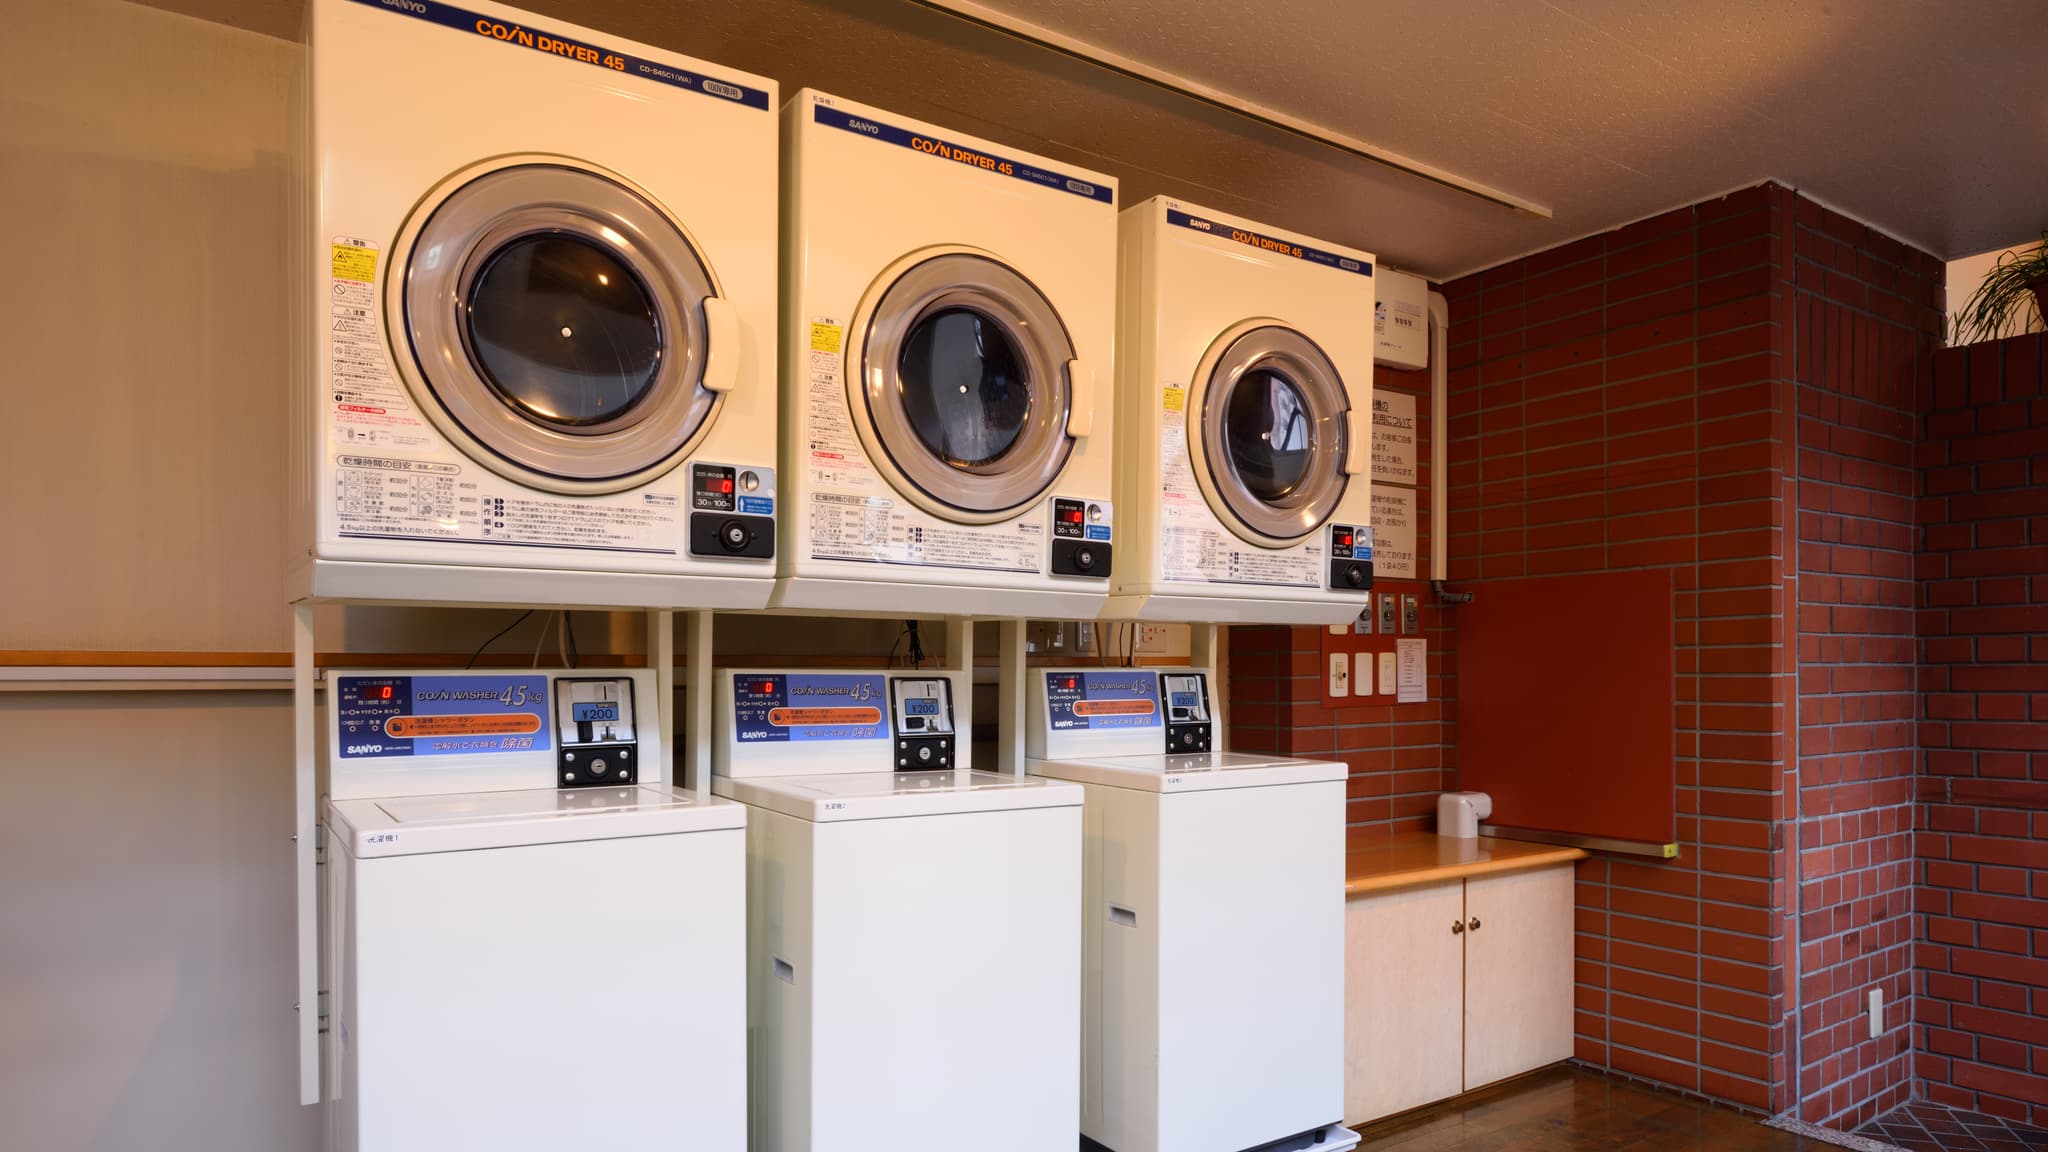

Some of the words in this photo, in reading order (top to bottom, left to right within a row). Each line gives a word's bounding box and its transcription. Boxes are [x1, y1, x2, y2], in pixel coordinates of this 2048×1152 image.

[538, 35, 600, 65] DRYER
[603, 55, 626, 72] 45
[849, 119, 879, 135] SANYO
[953, 149, 995, 171] DRYER
[997, 162, 1013, 176] 45
[1190, 218, 1211, 231] SANYO
[1261, 239, 1290, 255] DRYER
[1292, 247, 1302, 258] 45
[1373, 399, 1389, 411] 機の
[343, 457, 412, 470] 乾燥時間の目安
[722, 480, 731, 493] 0
[1074, 511, 1082, 523] 0
[765, 682, 773, 693] 0
[1069, 679, 1075, 689] 0
[382, 687, 392, 699] 0
[816, 687, 849, 695] WASHER
[452, 690, 499, 700] WASHER
[527, 692, 543, 705] kg
[582, 708, 613, 720] ¥200
[912, 704, 935, 714] ¥200
[742, 730, 767, 739] SANYO
[347, 743, 382, 755] SANYO
[501, 738, 533, 750] 除菌
